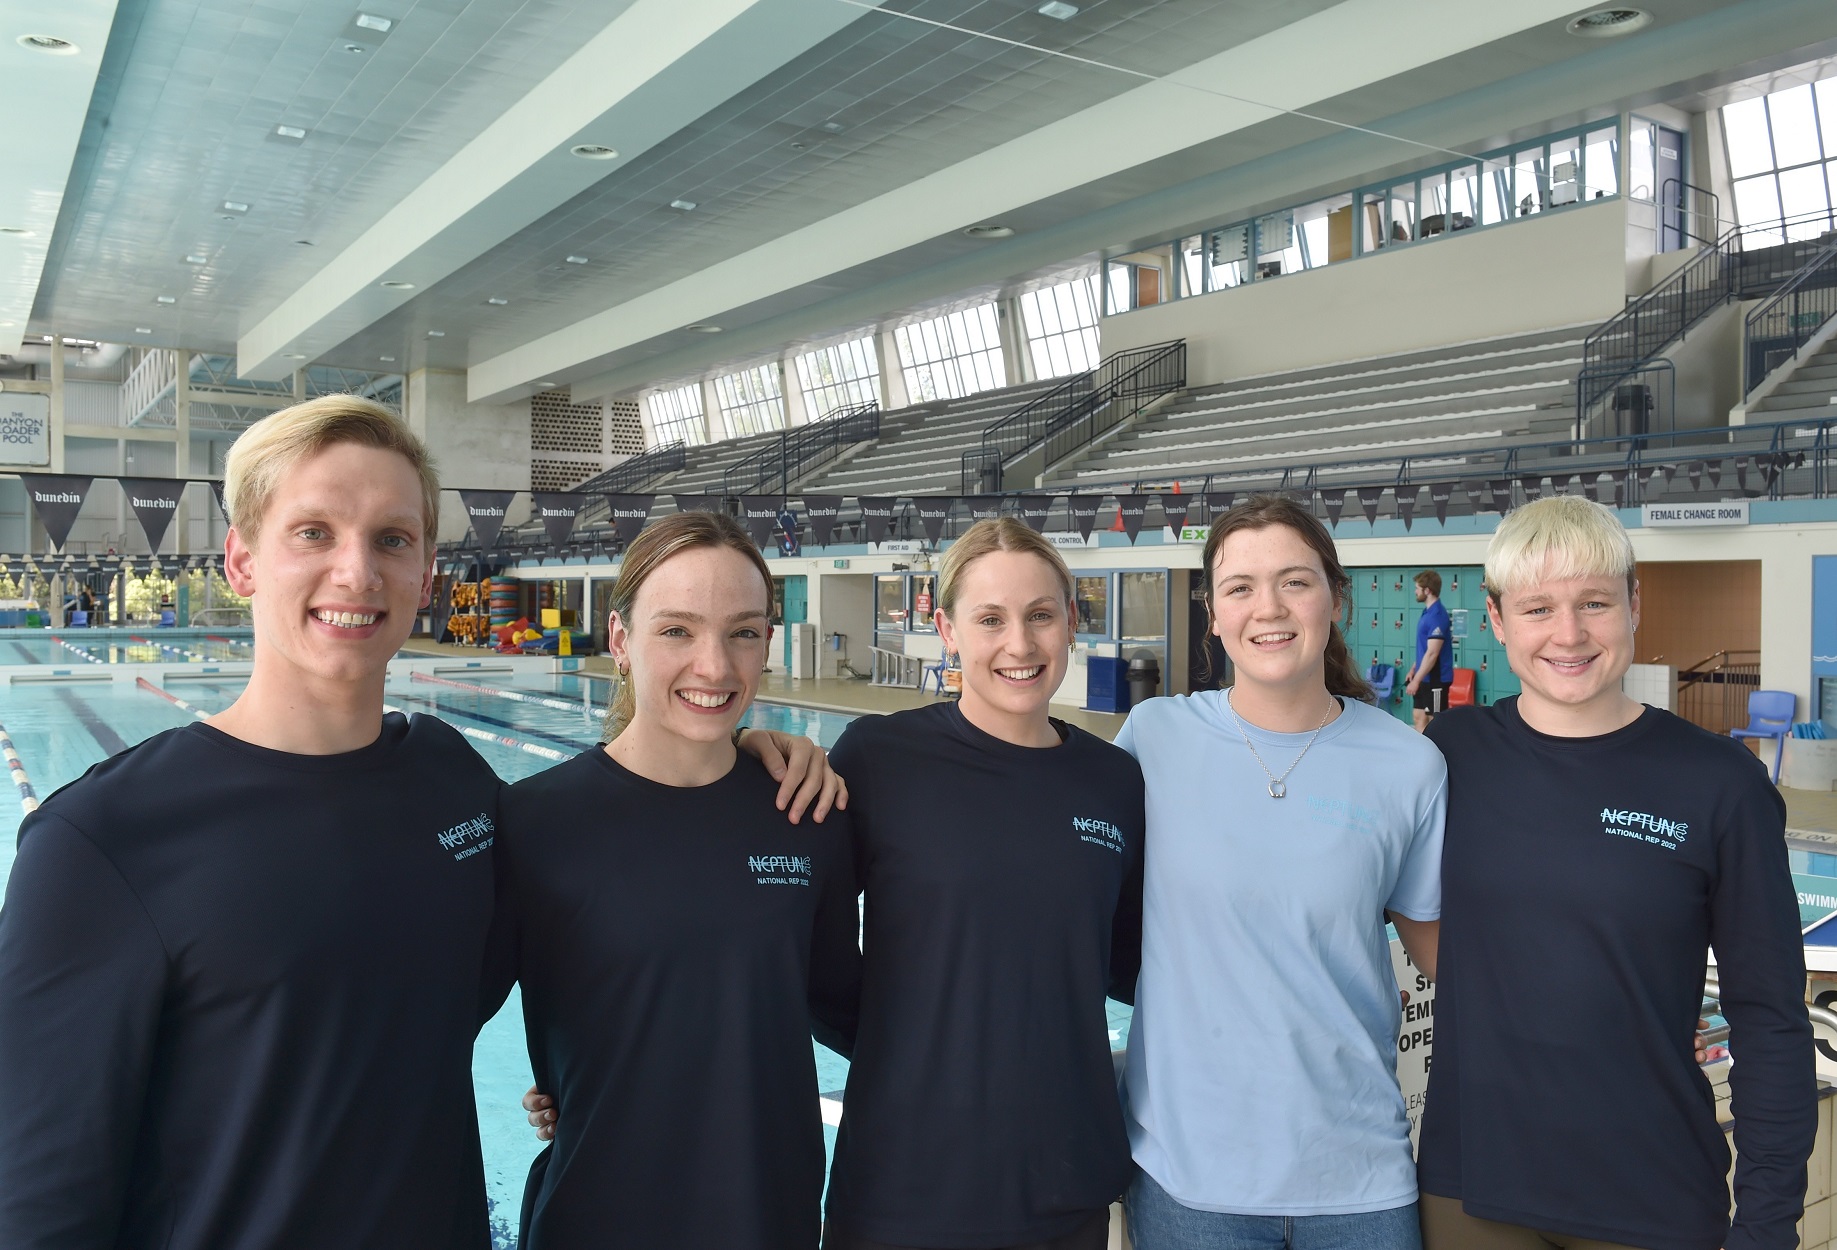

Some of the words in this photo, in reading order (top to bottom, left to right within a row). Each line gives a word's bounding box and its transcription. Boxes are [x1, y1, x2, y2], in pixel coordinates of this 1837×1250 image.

[0, 417, 43, 427] ANYON
[3, 434, 33, 444] POOL
[35, 491, 80, 503] dunedin
[133, 497, 175, 508] dunedin
[470, 506, 504, 517] dunedin
[542, 507, 575, 517] dunedin
[614, 508, 646, 518] dunedin
[809, 506, 837, 516] dunedin
[864, 507, 890, 517] dunedin
[1075, 508, 1095, 517] dunedin
[1121, 507, 1143, 516] dunedin
[1166, 505, 1186, 514] dunedin
[1209, 504, 1229, 512] dunedin
[747, 509, 776, 518] dunedin
[920, 509, 945, 518] dunedin
[1651, 510, 1682, 520] FEMALE
[1684, 509, 1716, 519] CHANGE
[1718, 508, 1741, 519] ROOM
[1600, 808, 1688, 842] NEPTUNE
[437, 812, 494, 851] NEPTUNE
[1081, 835, 1106, 847] NATIONAL
[1106, 841, 1115, 850] REP
[1605, 827, 1643, 840] NATIONAL
[1645, 835, 1660, 844] REP
[1661, 840, 1677, 850] 2022
[454, 845, 480, 862] NATIONAL
[478, 840, 488, 851] REP
[747, 855, 812, 876] NEPTUNE
[757, 877, 788, 885] NATIONAL
[789, 877, 800, 885] REP
